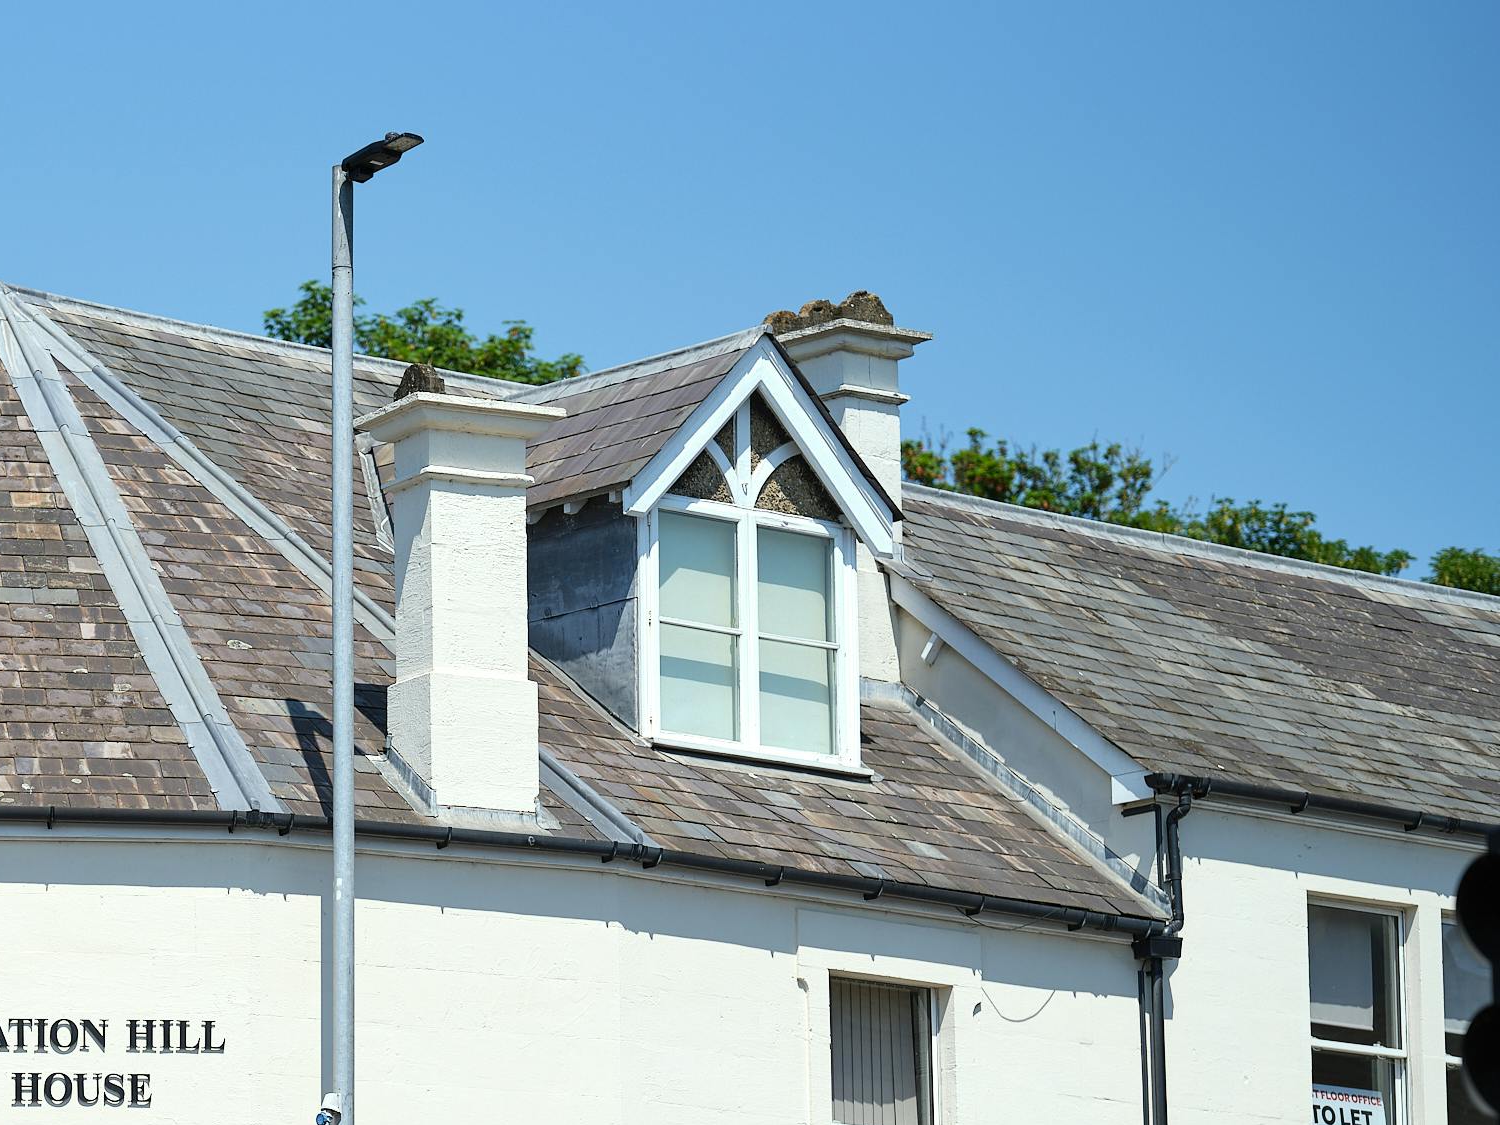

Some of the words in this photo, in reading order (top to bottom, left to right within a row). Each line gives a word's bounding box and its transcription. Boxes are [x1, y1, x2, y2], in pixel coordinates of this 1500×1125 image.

[126, 1019, 226, 1054] HILL
[11, 1072, 152, 1108] HOUSE
[1321, 1091, 1350, 1102] FLOOR
[1352, 1094, 1382, 1106] OFFICE
[1313, 1105, 1335, 1125] TO
